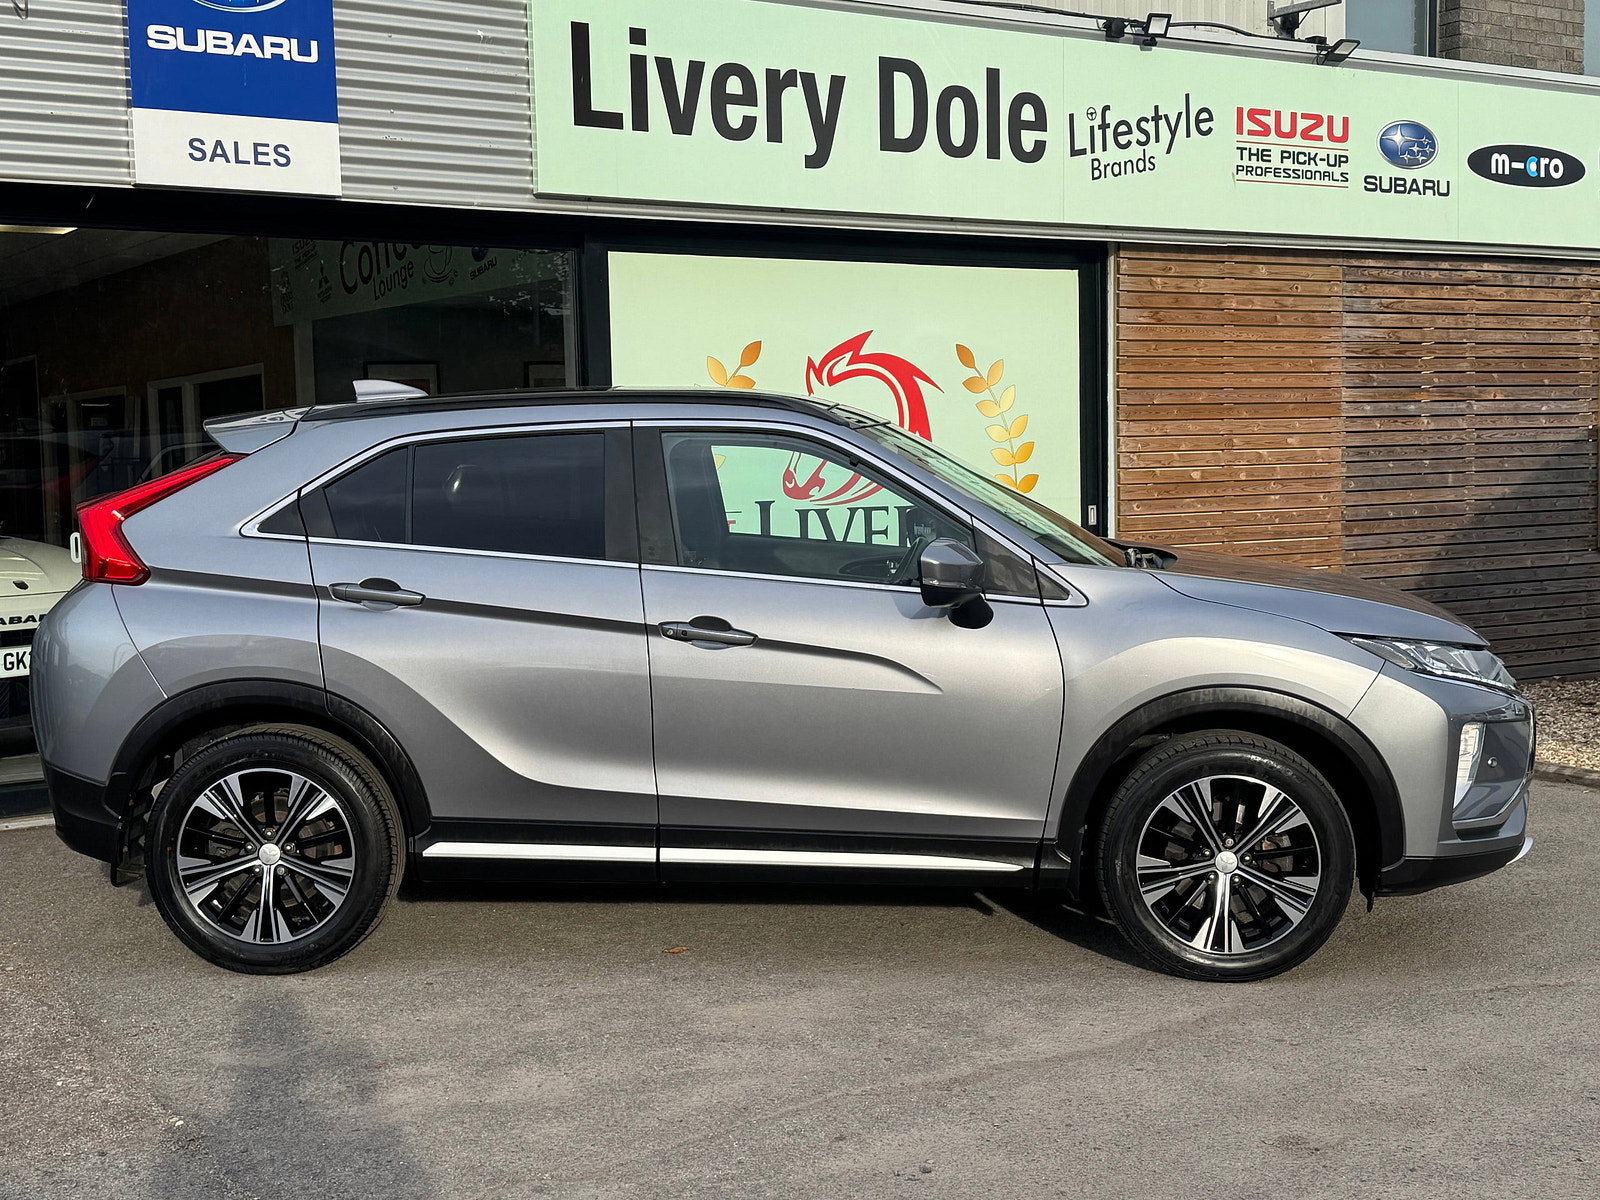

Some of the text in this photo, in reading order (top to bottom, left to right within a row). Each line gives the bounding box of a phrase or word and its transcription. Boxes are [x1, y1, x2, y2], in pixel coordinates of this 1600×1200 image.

[147, 24, 319, 63] SUBARU
[571, 21, 1048, 169] Livery Dole
[1068, 93, 1214, 158] Lifestyle
[1236, 106, 1349, 144] ISUZU
[188, 137, 291, 167] SALES
[1091, 148, 1156, 181] Brands
[1236, 147, 1349, 168] THE PICK-UP
[1236, 165, 1349, 182] PROFESSIONALS
[1363, 174, 1450, 197] SUBARU
[373, 260, 414, 300] Lounge
[469, 257, 497, 280] SUBARU
